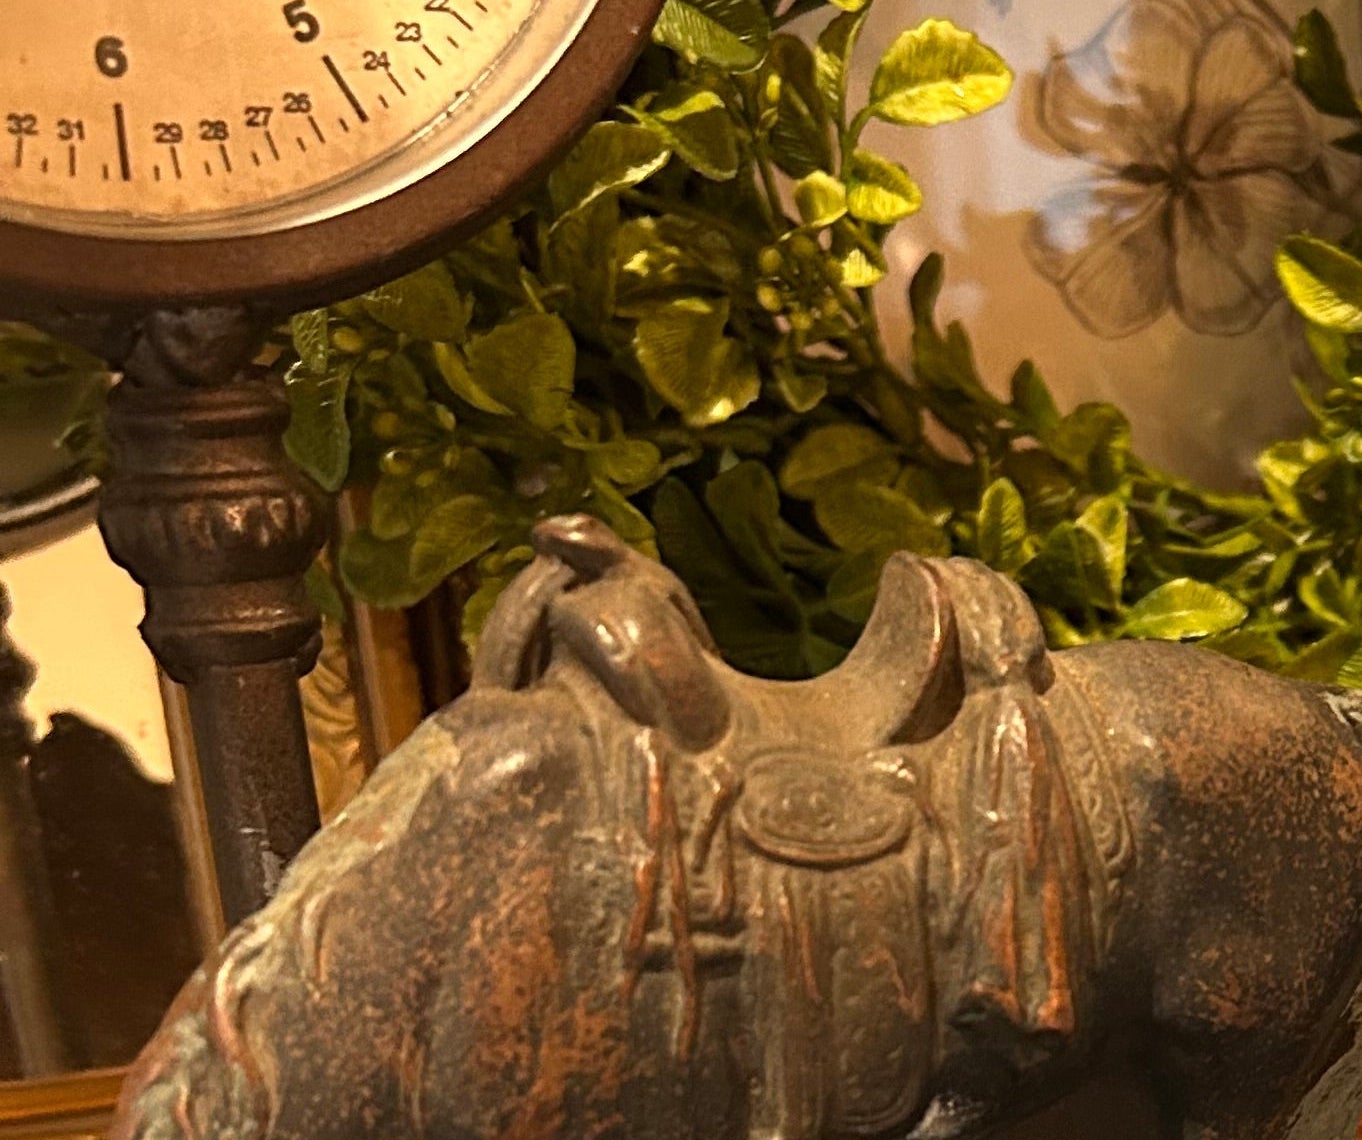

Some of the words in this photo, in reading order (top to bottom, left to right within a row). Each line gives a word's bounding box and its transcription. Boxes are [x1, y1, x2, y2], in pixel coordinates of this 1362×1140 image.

[282, 0, 320, 43] 5
[395, 22, 422, 42] 23
[95, 36, 128, 78] 6
[362, 50, 391, 71] 24
[282, 92, 312, 113] 26
[6, 113, 38, 136] 32
[245, 106, 273, 127] 27
[57, 118, 85, 141] 31
[153, 122, 183, 143] 29
[199, 120, 229, 142] 28
